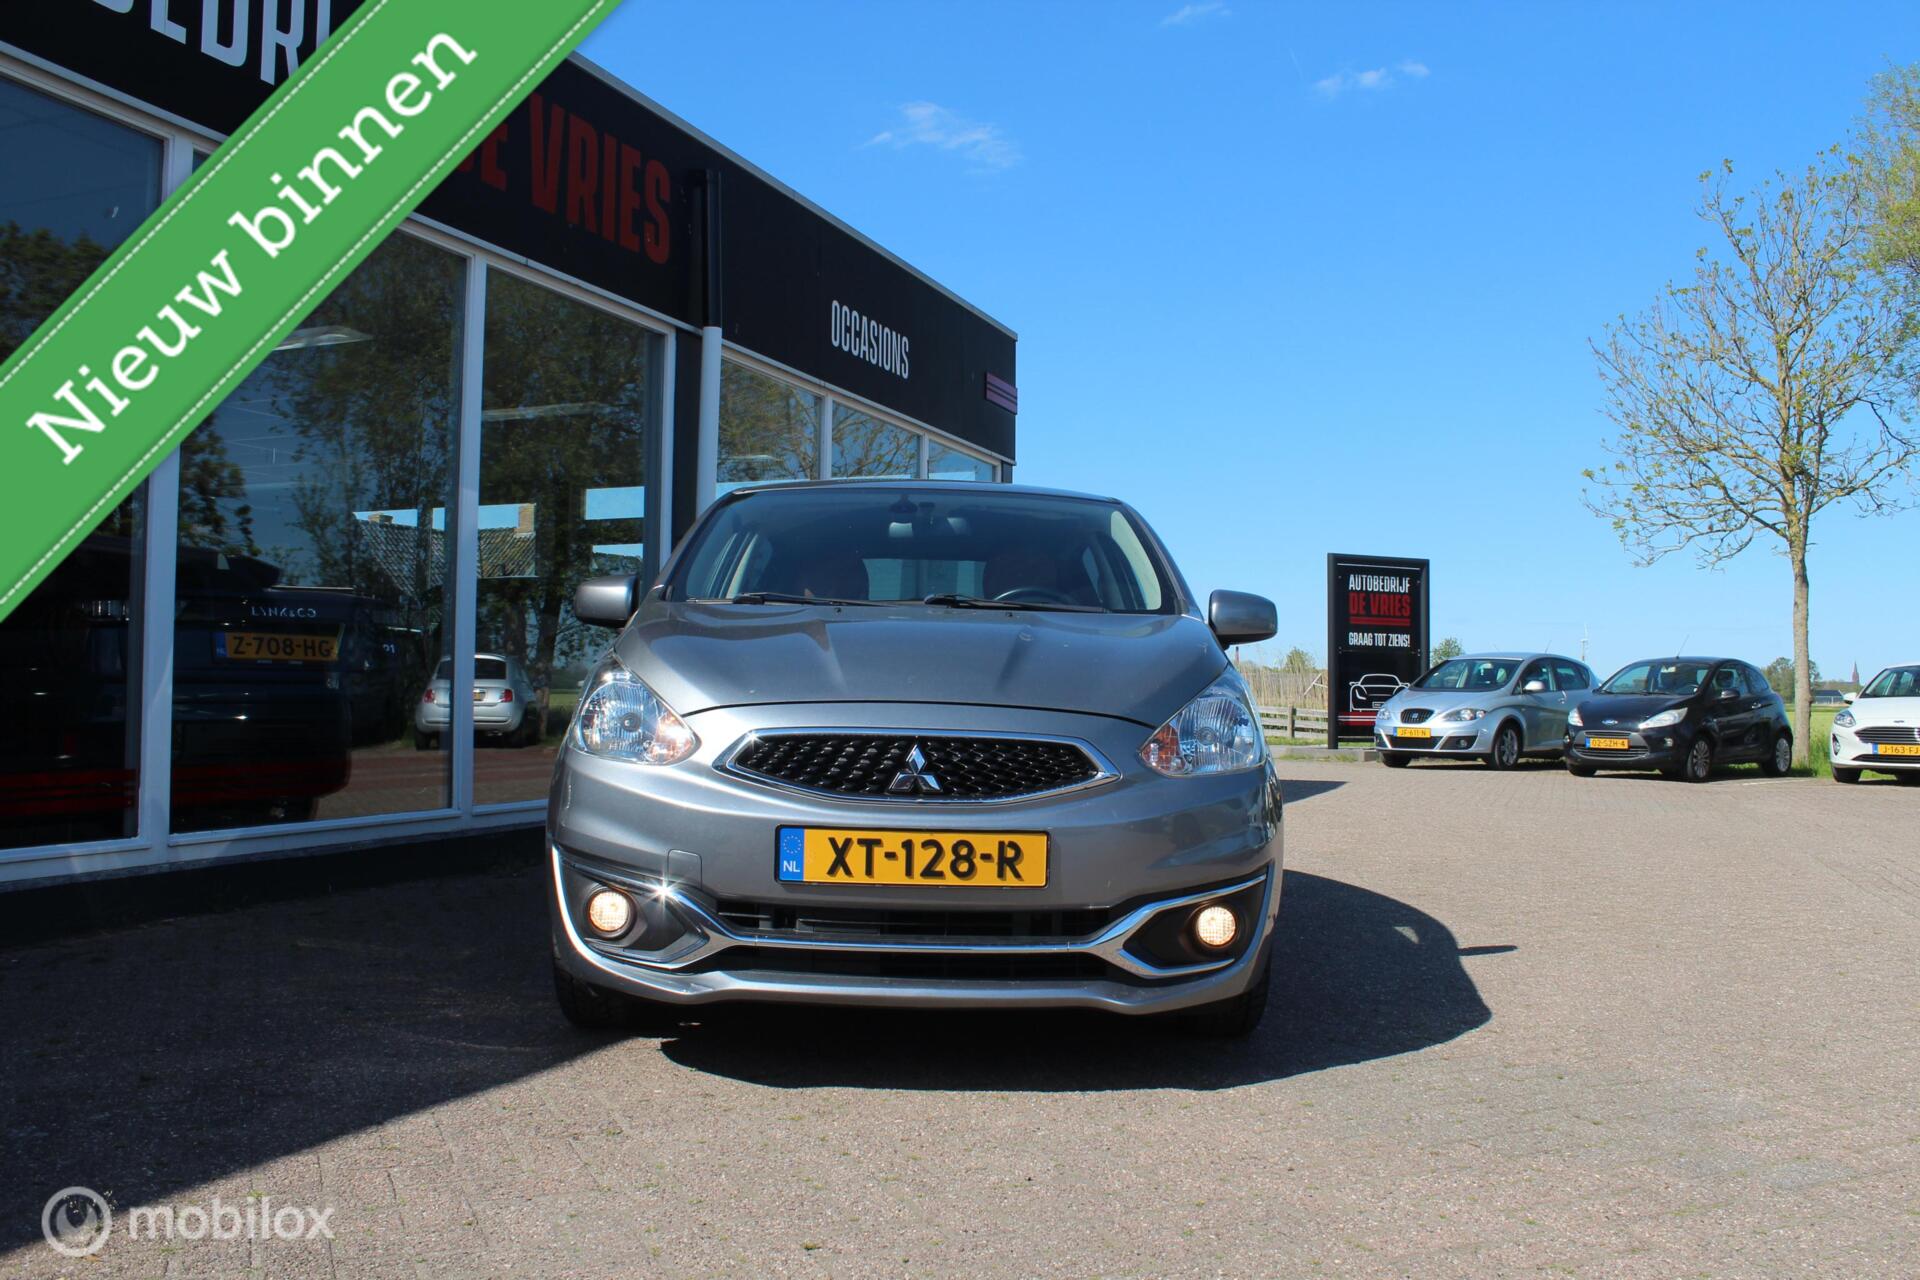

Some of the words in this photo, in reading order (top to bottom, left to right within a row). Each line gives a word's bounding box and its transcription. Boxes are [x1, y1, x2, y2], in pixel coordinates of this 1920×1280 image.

[456, 122, 508, 192] E
[530, 91, 671, 265] VRIES
[831, 299, 909, 379] OCCASIONS
[1349, 574, 1411, 593] AUTOBEDRIJF
[1349, 592, 1366, 615] DE
[1370, 593, 1411, 617] VRIES
[232, 635, 332, 658] Z-708-HG
[1348, 632, 1373, 646] GRAAG
[1374, 633, 1387, 647] TOT
[1388, 633, 1411, 648] ZIENS!
[1591, 738, 1626, 748] 02-SZH-4
[1882, 745, 1919, 755] J-163-FJ
[783, 860, 800, 873] NL
[826, 836, 1025, 882] XT-128-R
